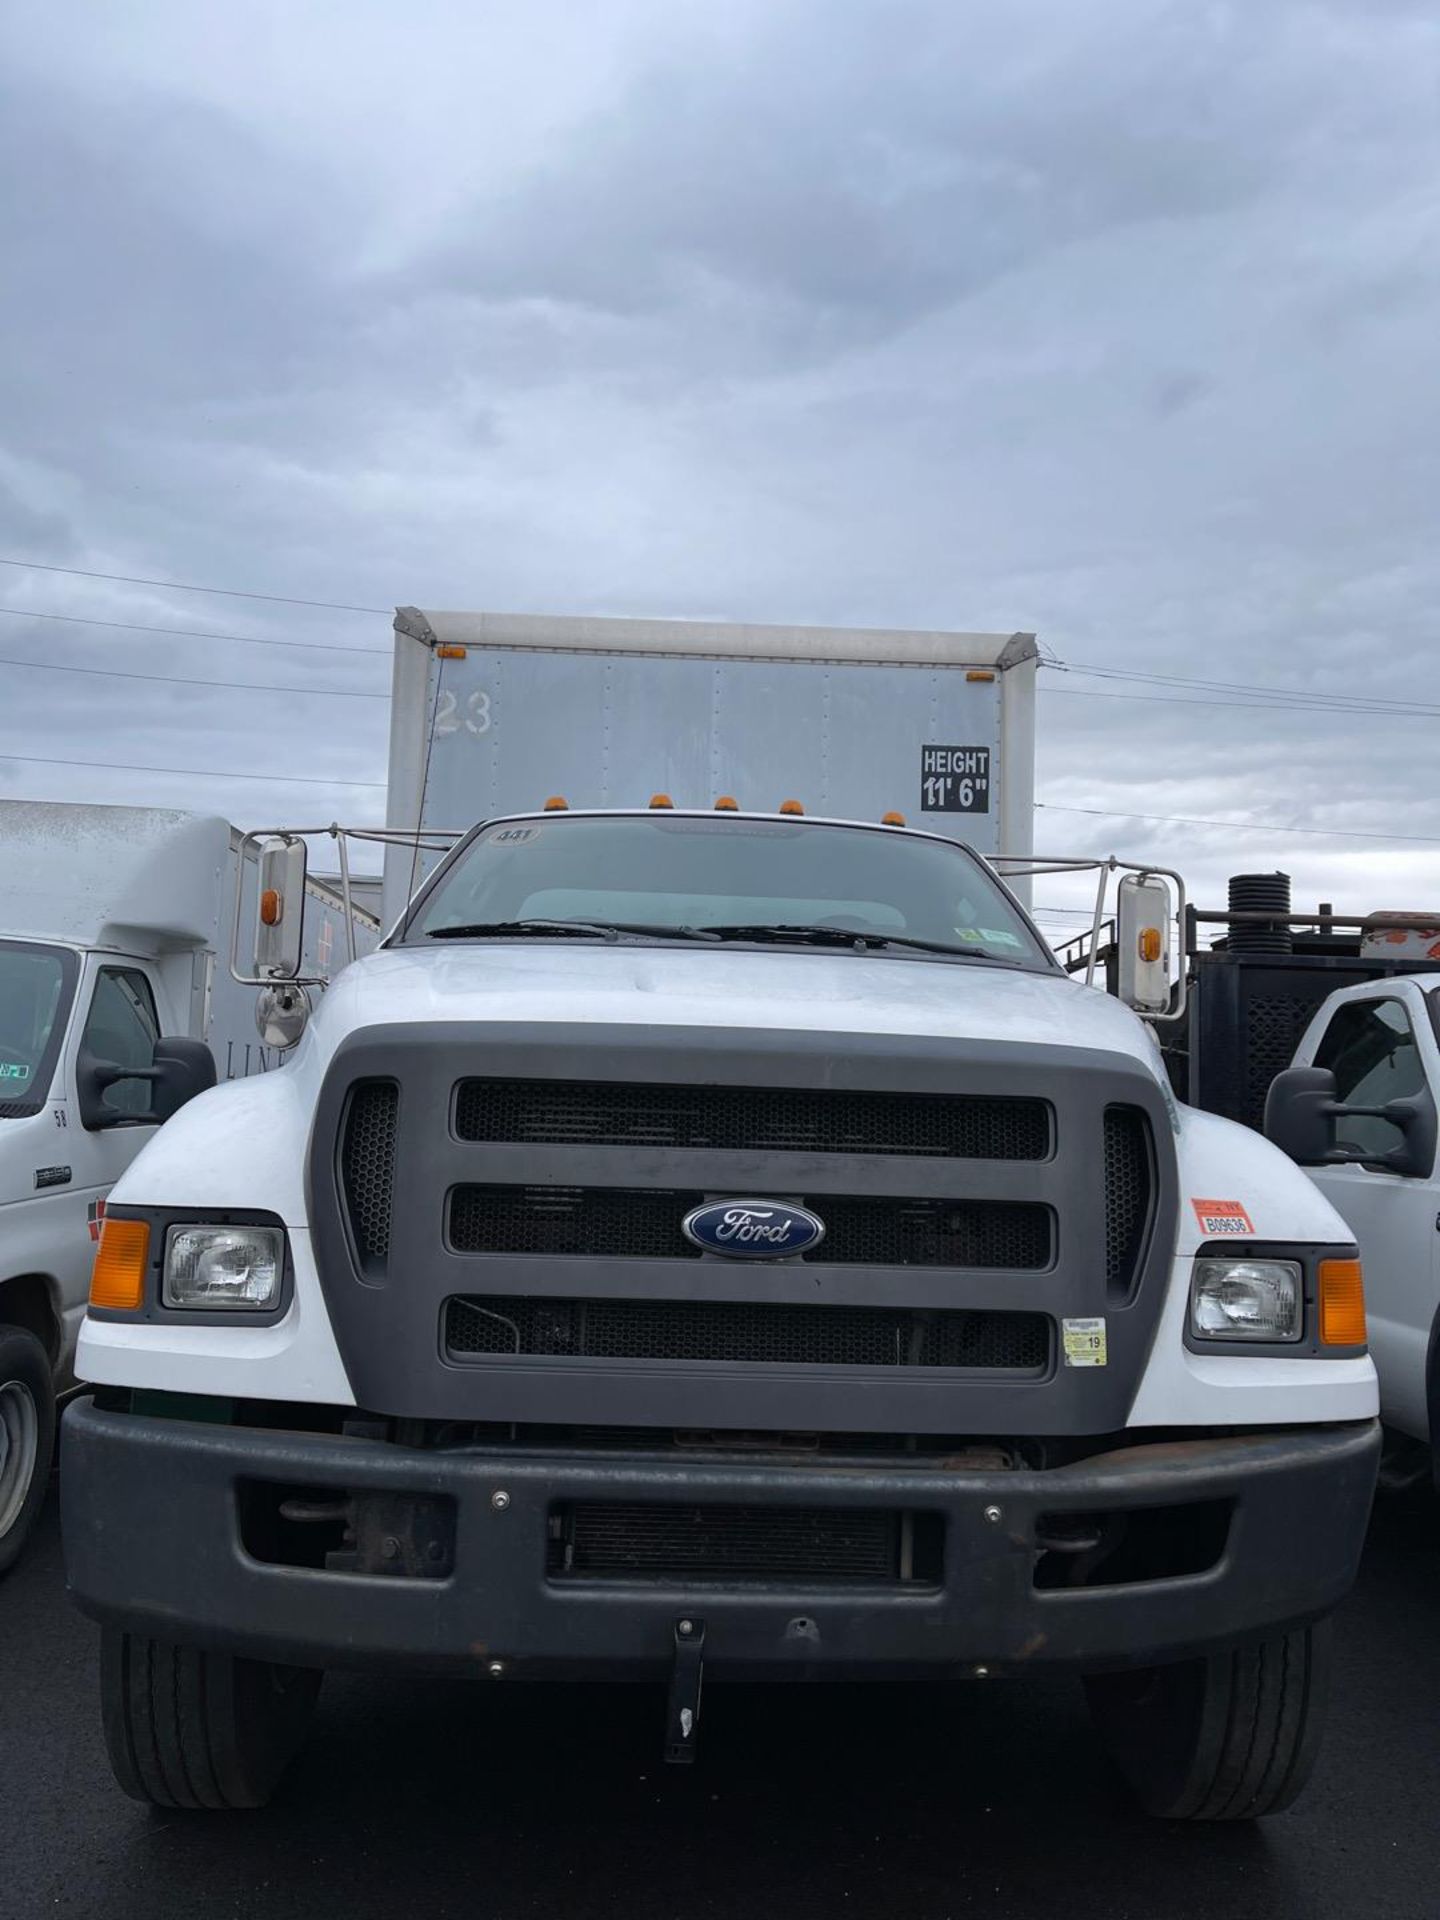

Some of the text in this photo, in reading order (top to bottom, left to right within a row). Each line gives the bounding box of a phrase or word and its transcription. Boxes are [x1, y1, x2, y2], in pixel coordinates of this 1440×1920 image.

[435, 690, 491, 735] 23
[924, 751, 988, 774] HEIGHT
[959, 778, 987, 807] 6"
[53, 1109, 67, 1128] 58
[715, 1208, 792, 1243] Ford
[1088, 1336, 1101, 1349] 19
